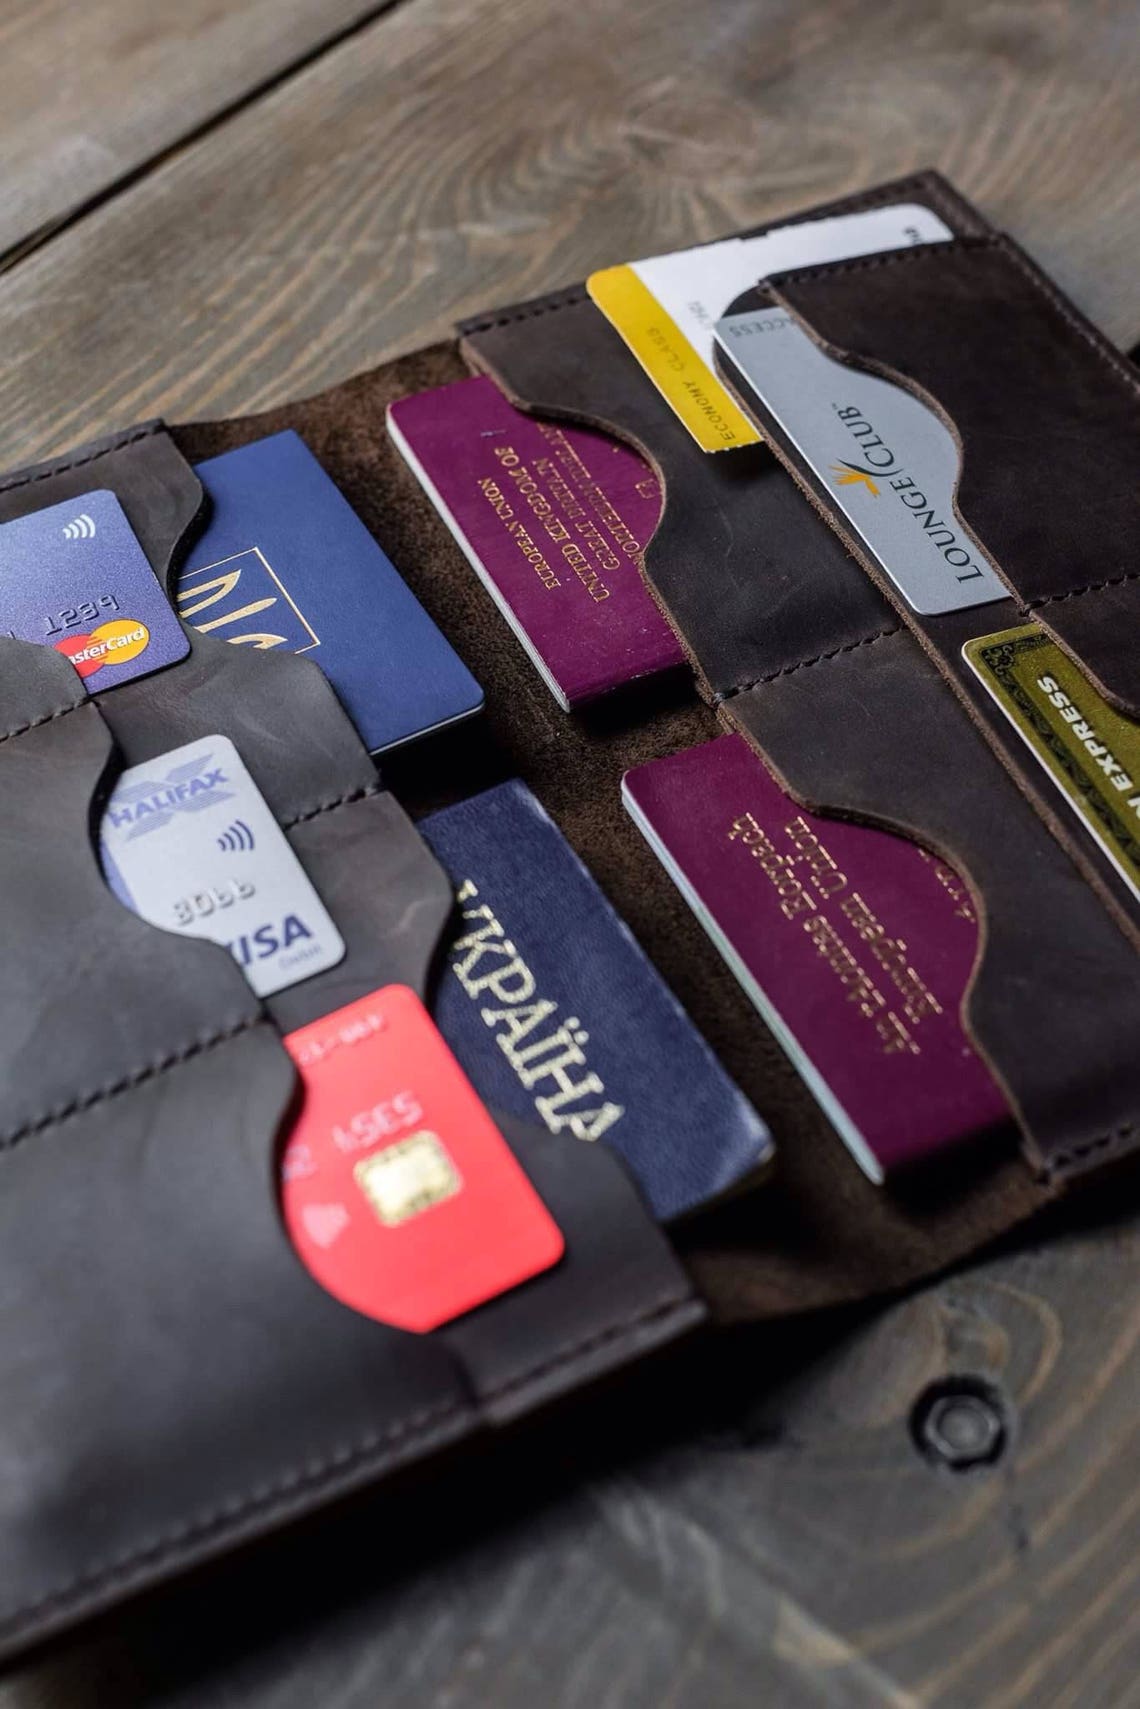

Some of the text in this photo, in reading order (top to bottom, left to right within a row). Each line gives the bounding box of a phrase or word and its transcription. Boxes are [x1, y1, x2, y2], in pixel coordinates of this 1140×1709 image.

[644, 326, 686, 374] CLASS
[727, 318, 794, 339] CCESS
[682, 379, 736, 441] ECONOMY
[477, 477, 561, 590] EUROPEAN UNION
[494, 446, 610, 603] UNITED KINGDOM OF
[575, 520, 620, 570] GREAT
[889, 478, 984, 583] LOUNGE
[45, 593, 120, 636] 1239
[1036, 675, 1133, 792] EXPRESS
[107, 767, 229, 829] HALIFAX
[785, 815, 943, 1024] European Union
